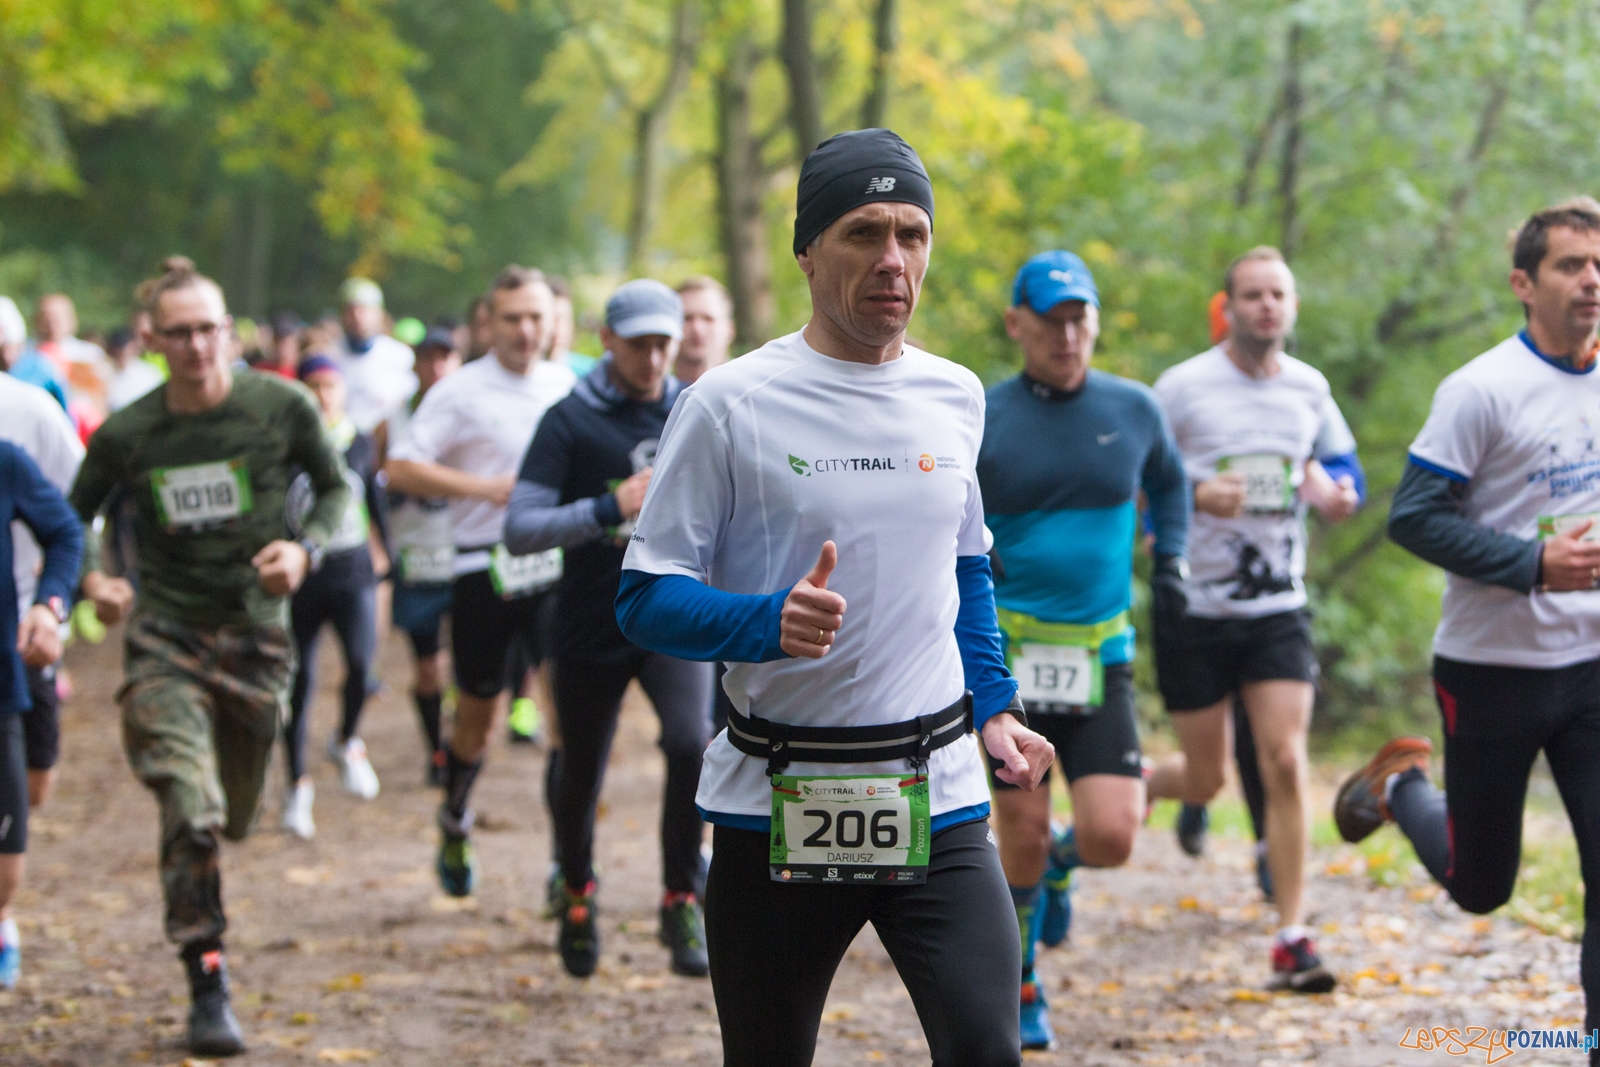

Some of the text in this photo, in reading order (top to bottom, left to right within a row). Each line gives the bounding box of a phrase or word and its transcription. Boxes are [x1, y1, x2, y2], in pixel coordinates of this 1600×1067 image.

[1032, 664, 1078, 691] 137
[802, 809, 898, 848] 206
[915, 818, 925, 854] Poznań
[827, 852, 873, 863] DARIUSZ
